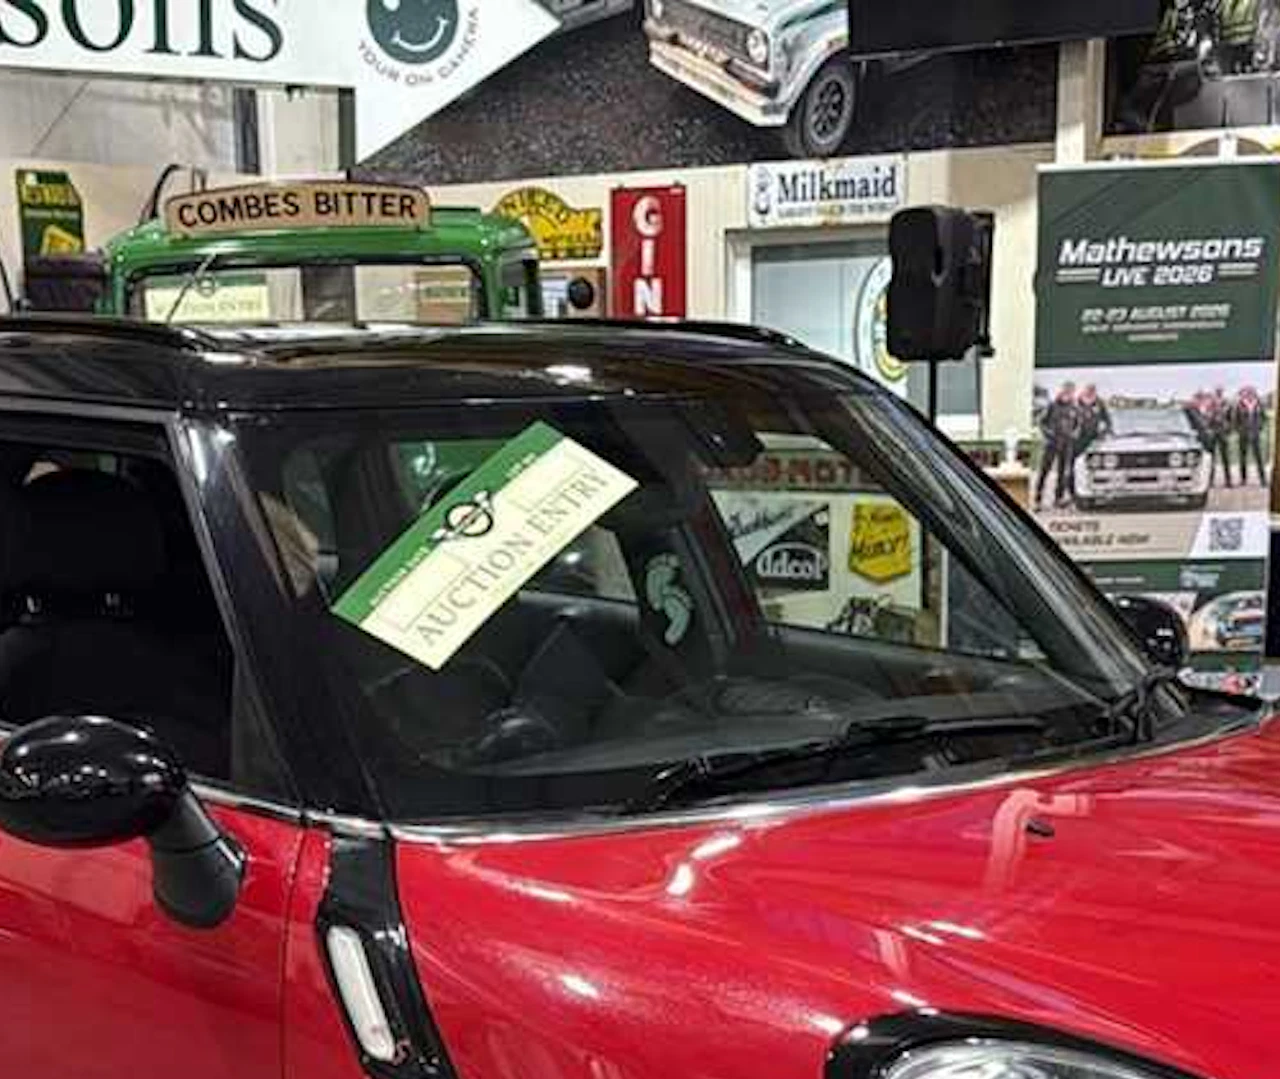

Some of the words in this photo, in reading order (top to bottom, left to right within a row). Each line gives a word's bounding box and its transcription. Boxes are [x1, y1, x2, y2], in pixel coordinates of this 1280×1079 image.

[777, 165, 896, 203] Milkmaid
[177, 191, 301, 228] COMBES
[314, 190, 418, 218] BITTER
[1057, 234, 1266, 266] Mathewsons
[1101, 266, 1151, 287] LIVE
[1152, 263, 1215, 286] 2026
[416, 531, 533, 647] AUCTION
[525, 463, 611, 536] ENTRY
